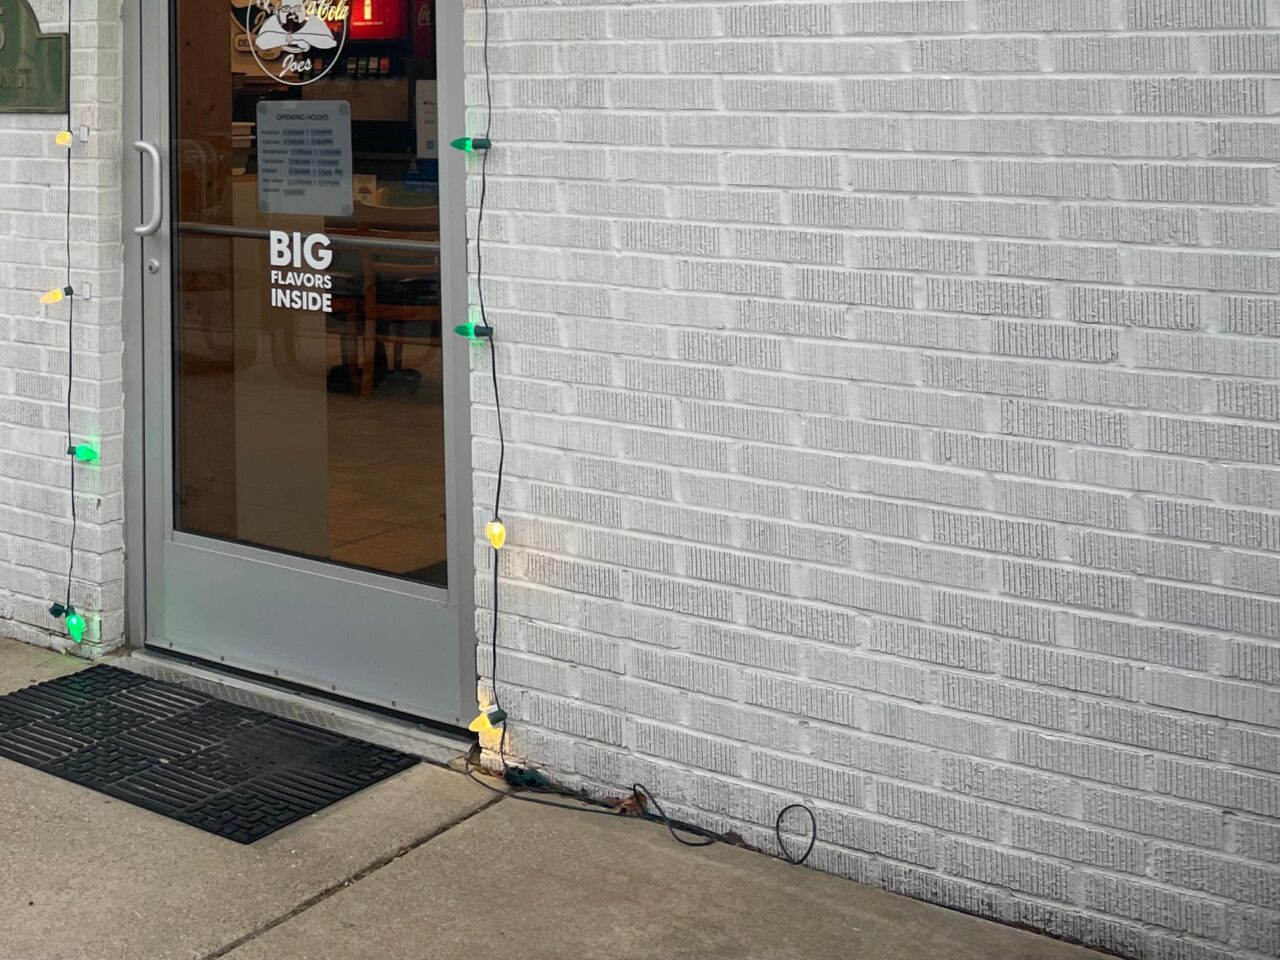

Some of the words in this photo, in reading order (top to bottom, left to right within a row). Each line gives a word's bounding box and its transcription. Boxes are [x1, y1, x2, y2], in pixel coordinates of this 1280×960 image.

[279, 53, 313, 78] Joes
[276, 113, 305, 121] OPENING
[305, 113, 329, 121] HOURS
[269, 230, 333, 270] BIG
[271, 270, 332, 289] FLAVORS
[271, 288, 332, 313] INSIDE
